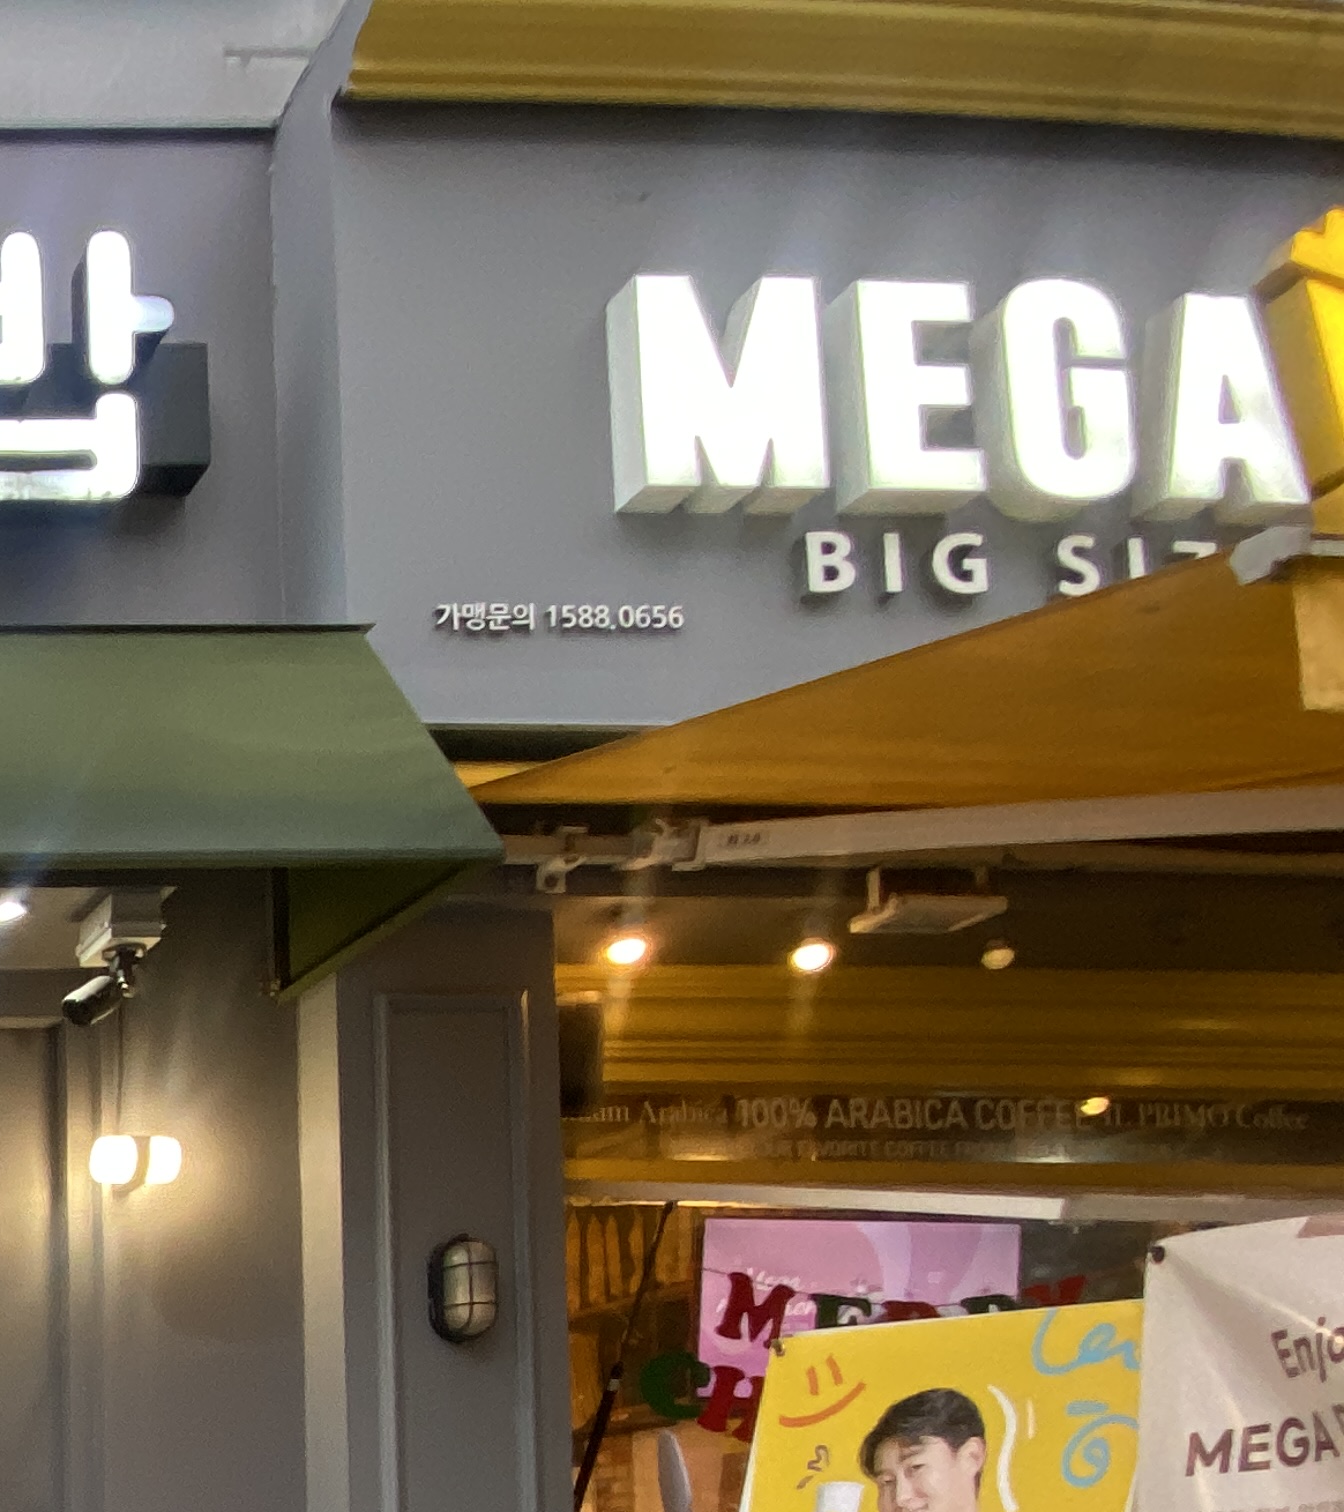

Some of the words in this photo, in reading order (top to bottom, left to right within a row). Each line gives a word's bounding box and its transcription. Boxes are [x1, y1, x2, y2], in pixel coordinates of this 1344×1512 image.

[605, 274, 1312, 516] MEGA
[805, 531, 989, 594] BIG
[435, 603, 535, 632] 가맹문의
[736, 1098, 817, 1128] 100%
[824, 1097, 967, 1130] ARABICA
